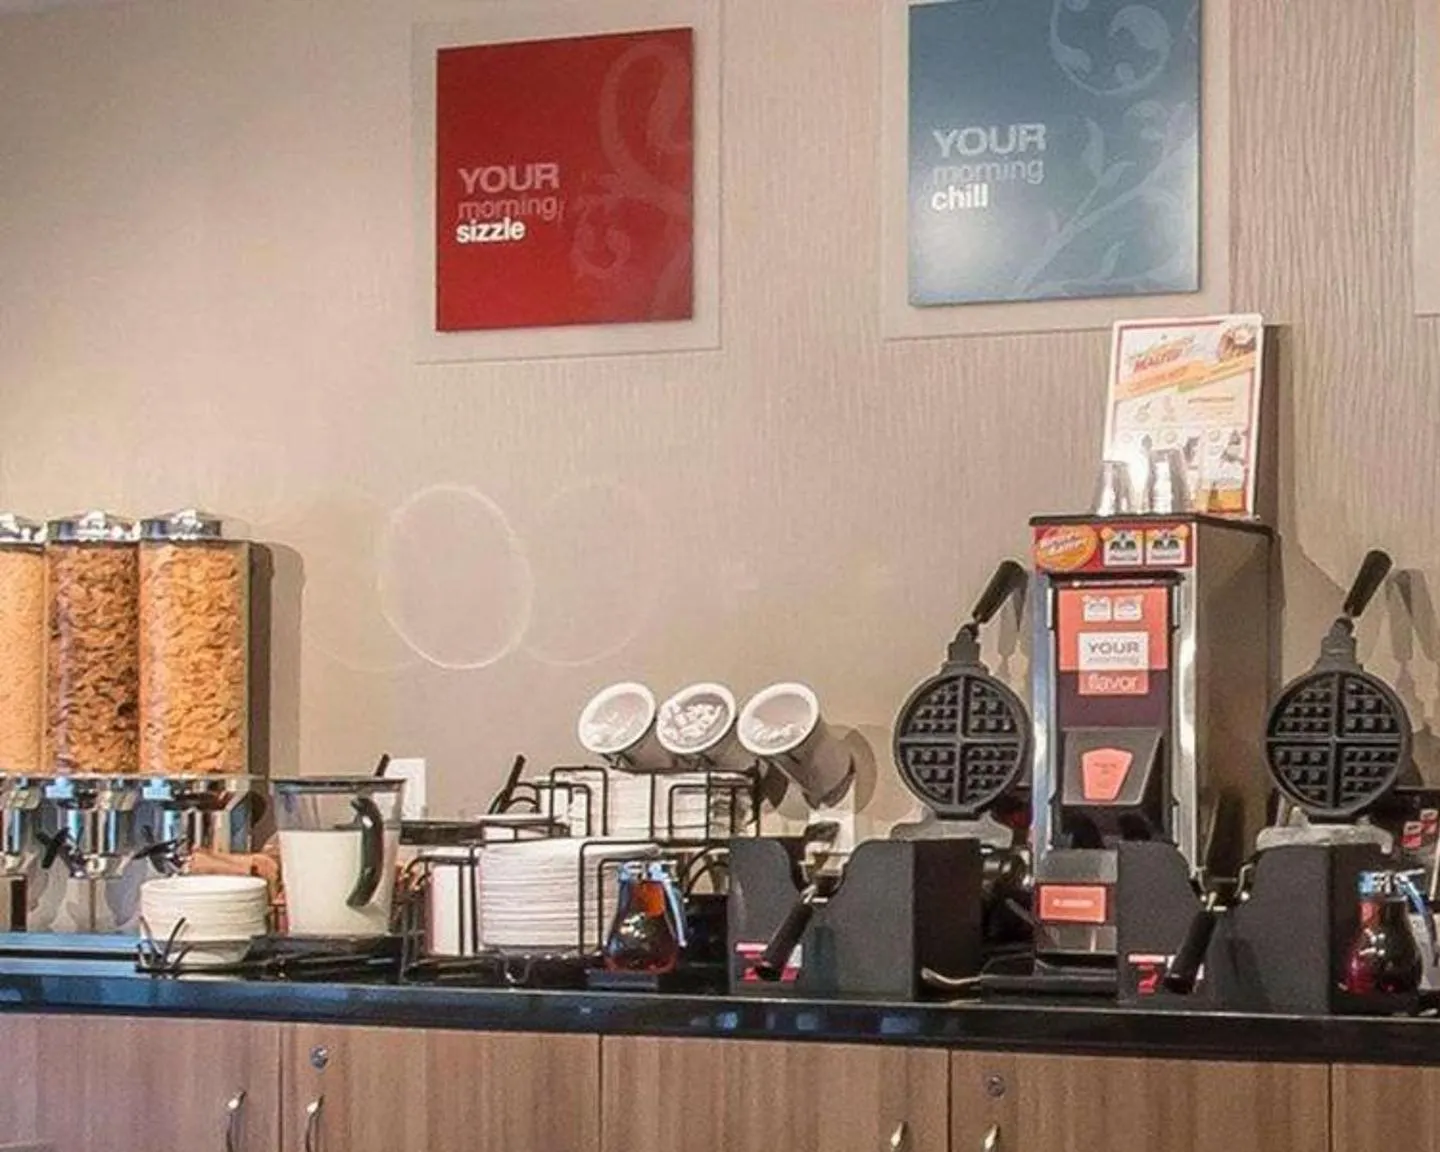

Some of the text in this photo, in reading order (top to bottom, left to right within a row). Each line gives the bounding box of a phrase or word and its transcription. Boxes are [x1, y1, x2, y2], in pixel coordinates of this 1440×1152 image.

[931, 122, 1047, 158] YOUR
[457, 162, 560, 195] YOUR
[932, 156, 1045, 185] morning
[457, 194, 558, 222] morning
[931, 183, 989, 211] chill
[456, 216, 526, 244] sizzle
[1087, 641, 1140, 654] YOUR
